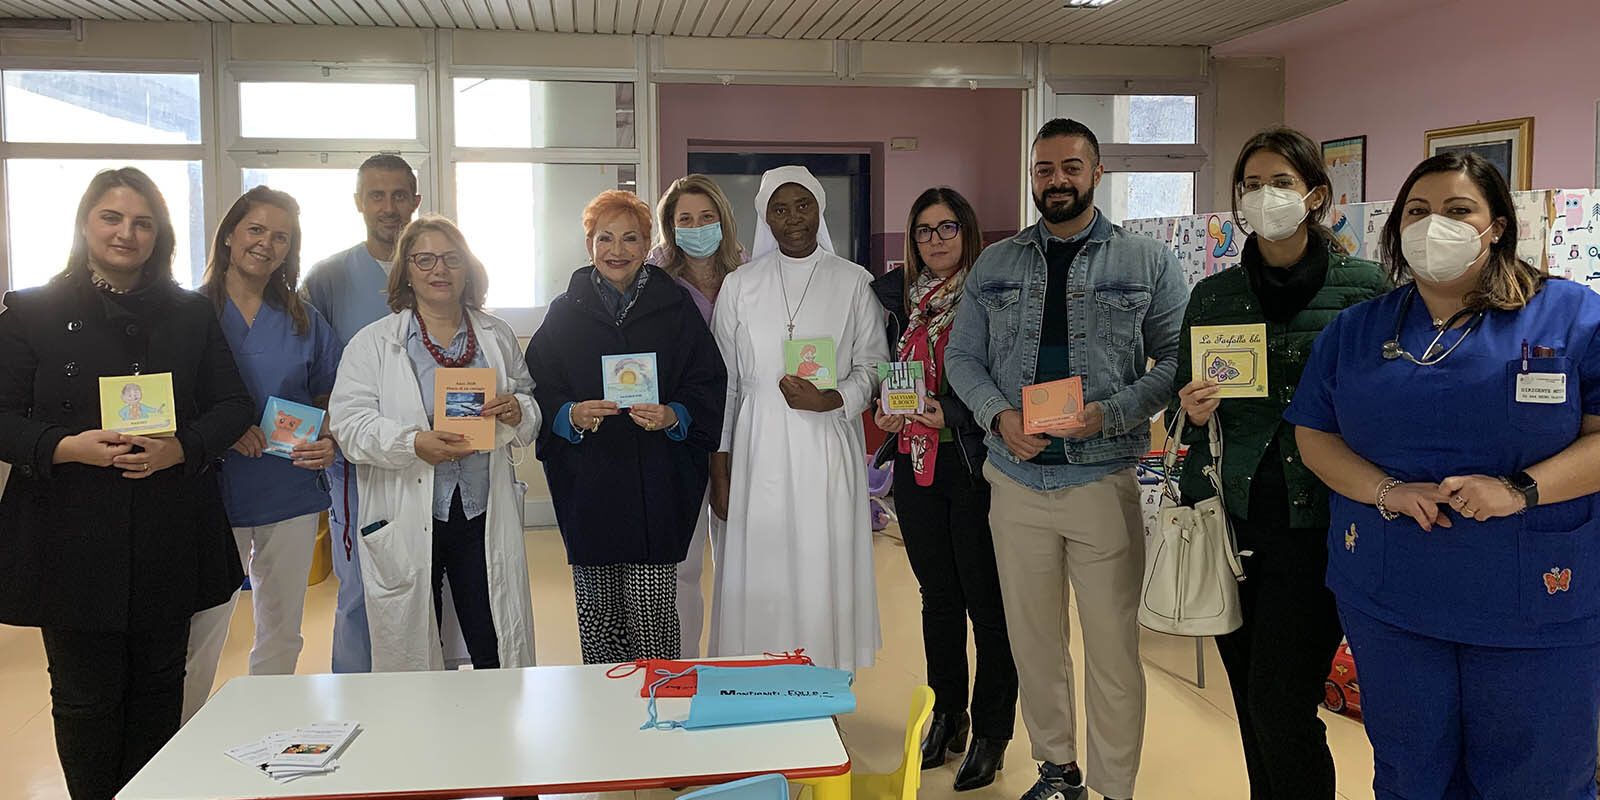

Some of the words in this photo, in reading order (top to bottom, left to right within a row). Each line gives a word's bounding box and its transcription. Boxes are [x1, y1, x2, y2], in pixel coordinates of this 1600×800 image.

[1199, 334, 1211, 344] La
[1214, 334, 1246, 347] Farfalla
[1247, 334, 1261, 344] blu
